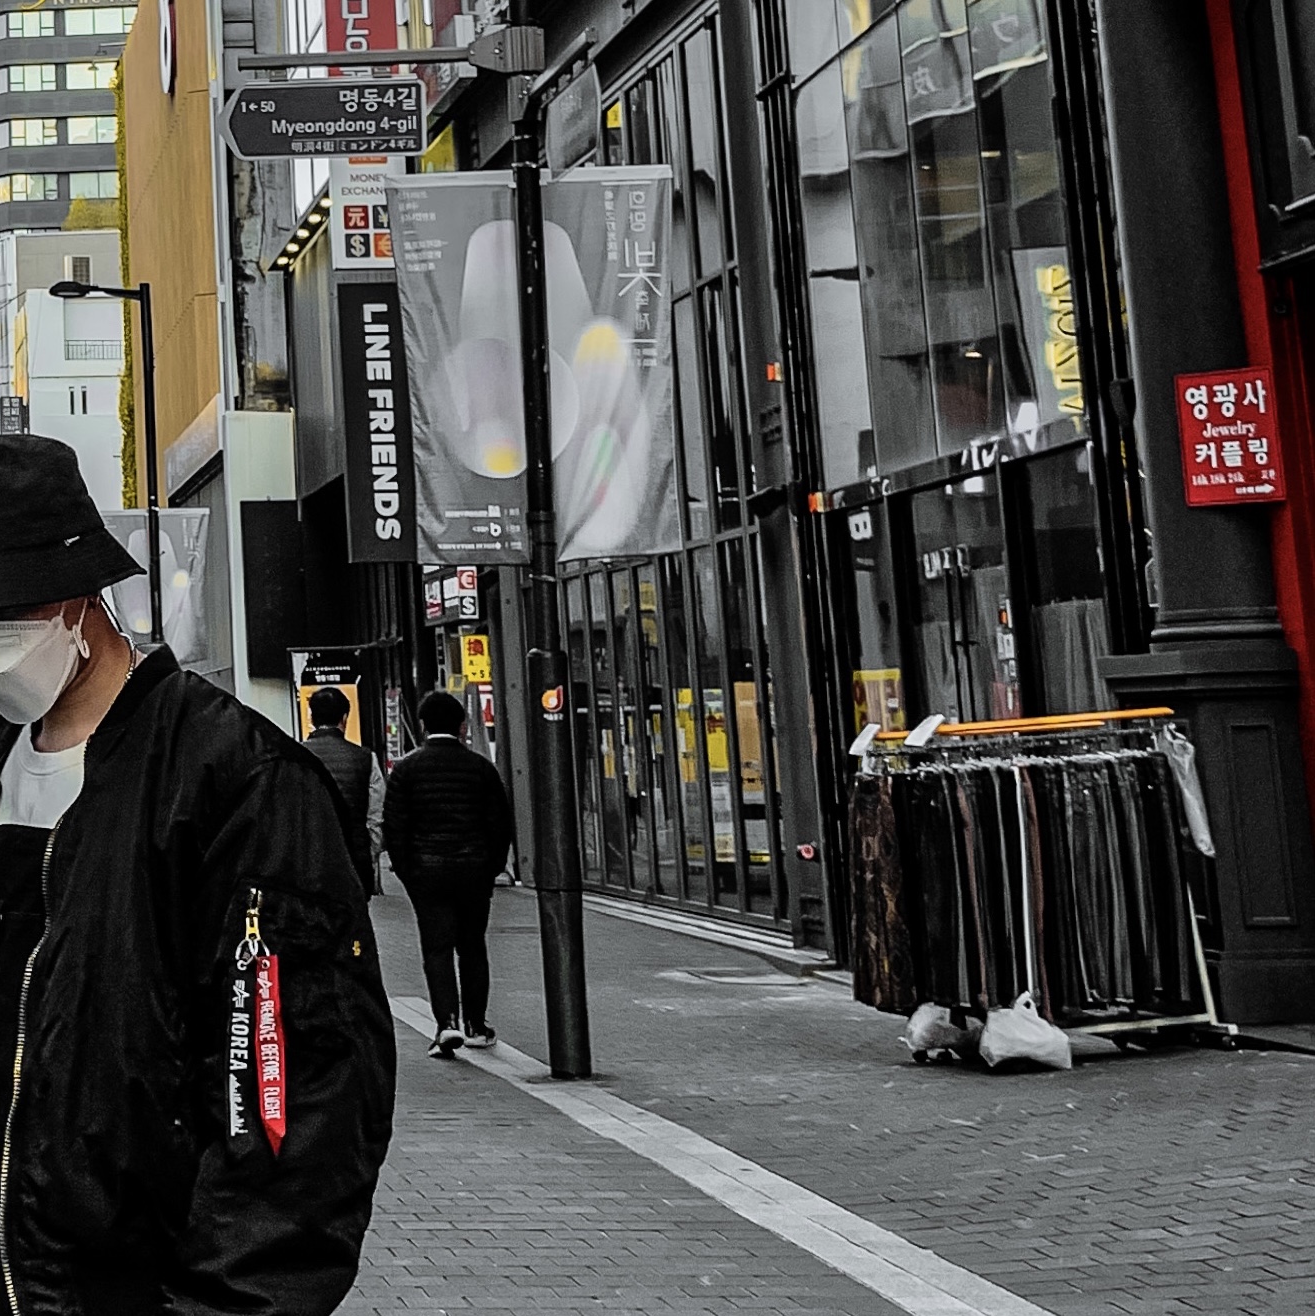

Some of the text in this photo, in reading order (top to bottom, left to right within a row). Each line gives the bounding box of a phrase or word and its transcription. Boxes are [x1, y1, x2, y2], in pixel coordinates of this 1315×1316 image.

[338, 86, 418, 112] 명동4길
[271, 114, 418, 137] Myeongdong 4-gil
[347, 207, 365, 227] 元
[1184, 379, 1267, 420] 영광사
[362, 302, 403, 541] LINE FRIENDS
[1202, 420, 1257, 438] Jewelry
[1194, 437, 1269, 469] 커플링
[229, 1011, 250, 1072] KOREA
[259, 999, 282, 1120] REMOVE BEFORE FLIGHT
